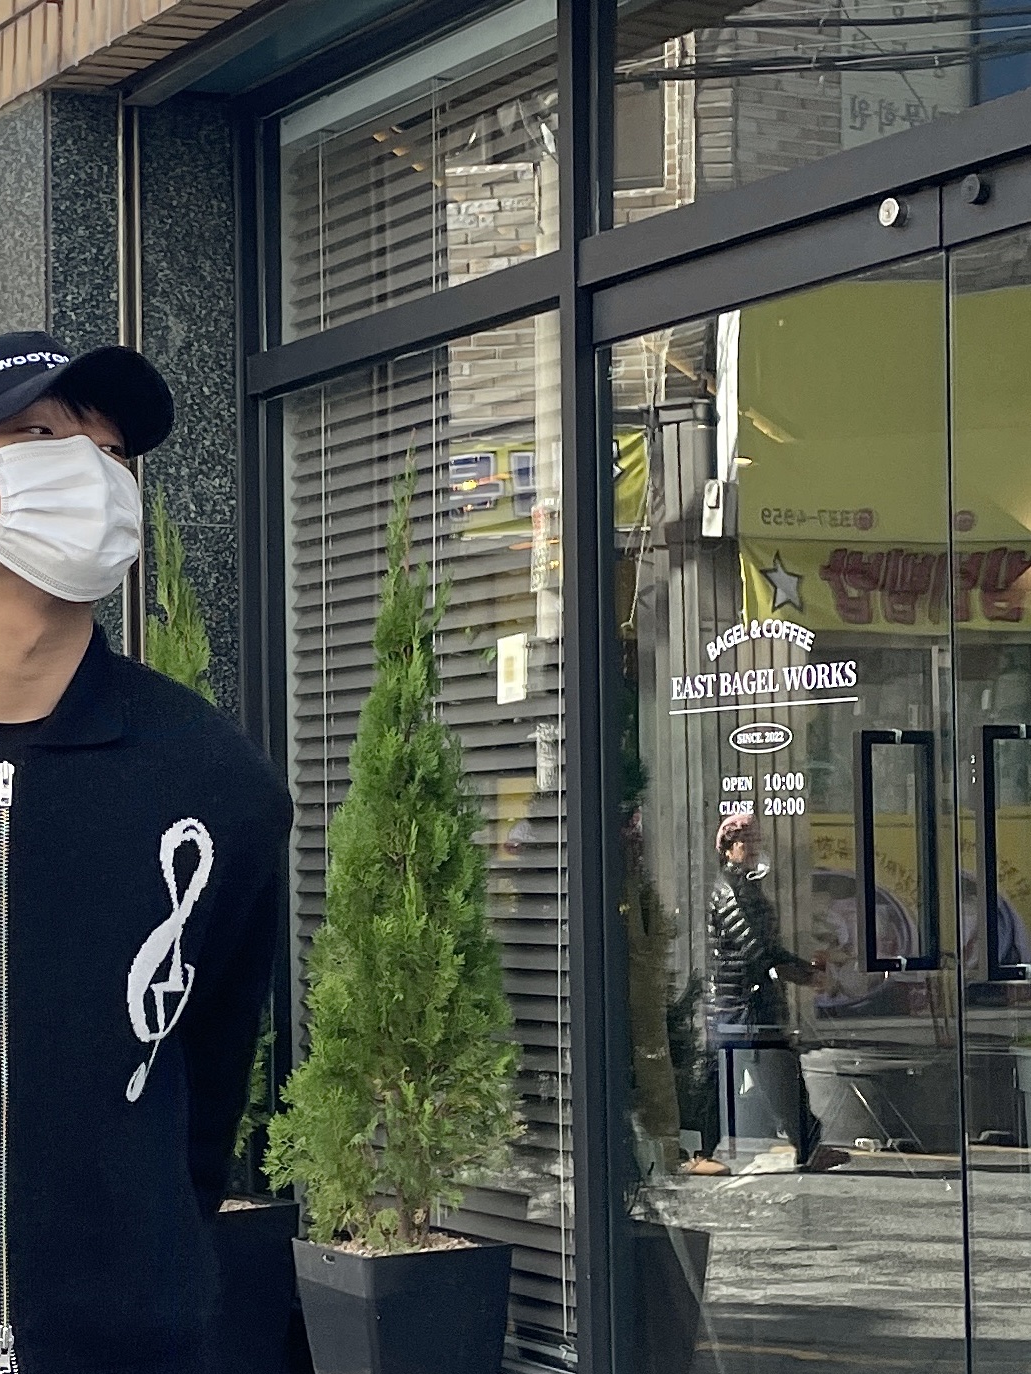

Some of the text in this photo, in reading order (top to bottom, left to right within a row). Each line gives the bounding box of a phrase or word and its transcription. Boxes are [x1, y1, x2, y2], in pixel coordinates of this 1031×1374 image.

[706, 618, 817, 662] BAGEL & COFFEE
[671, 660, 857, 700] EAST BAGEL WORKS
[764, 731, 785, 743] 2022
[722, 772, 805, 792] OPEN 10:00
[719, 797, 805, 816] CLOSE 20:00
